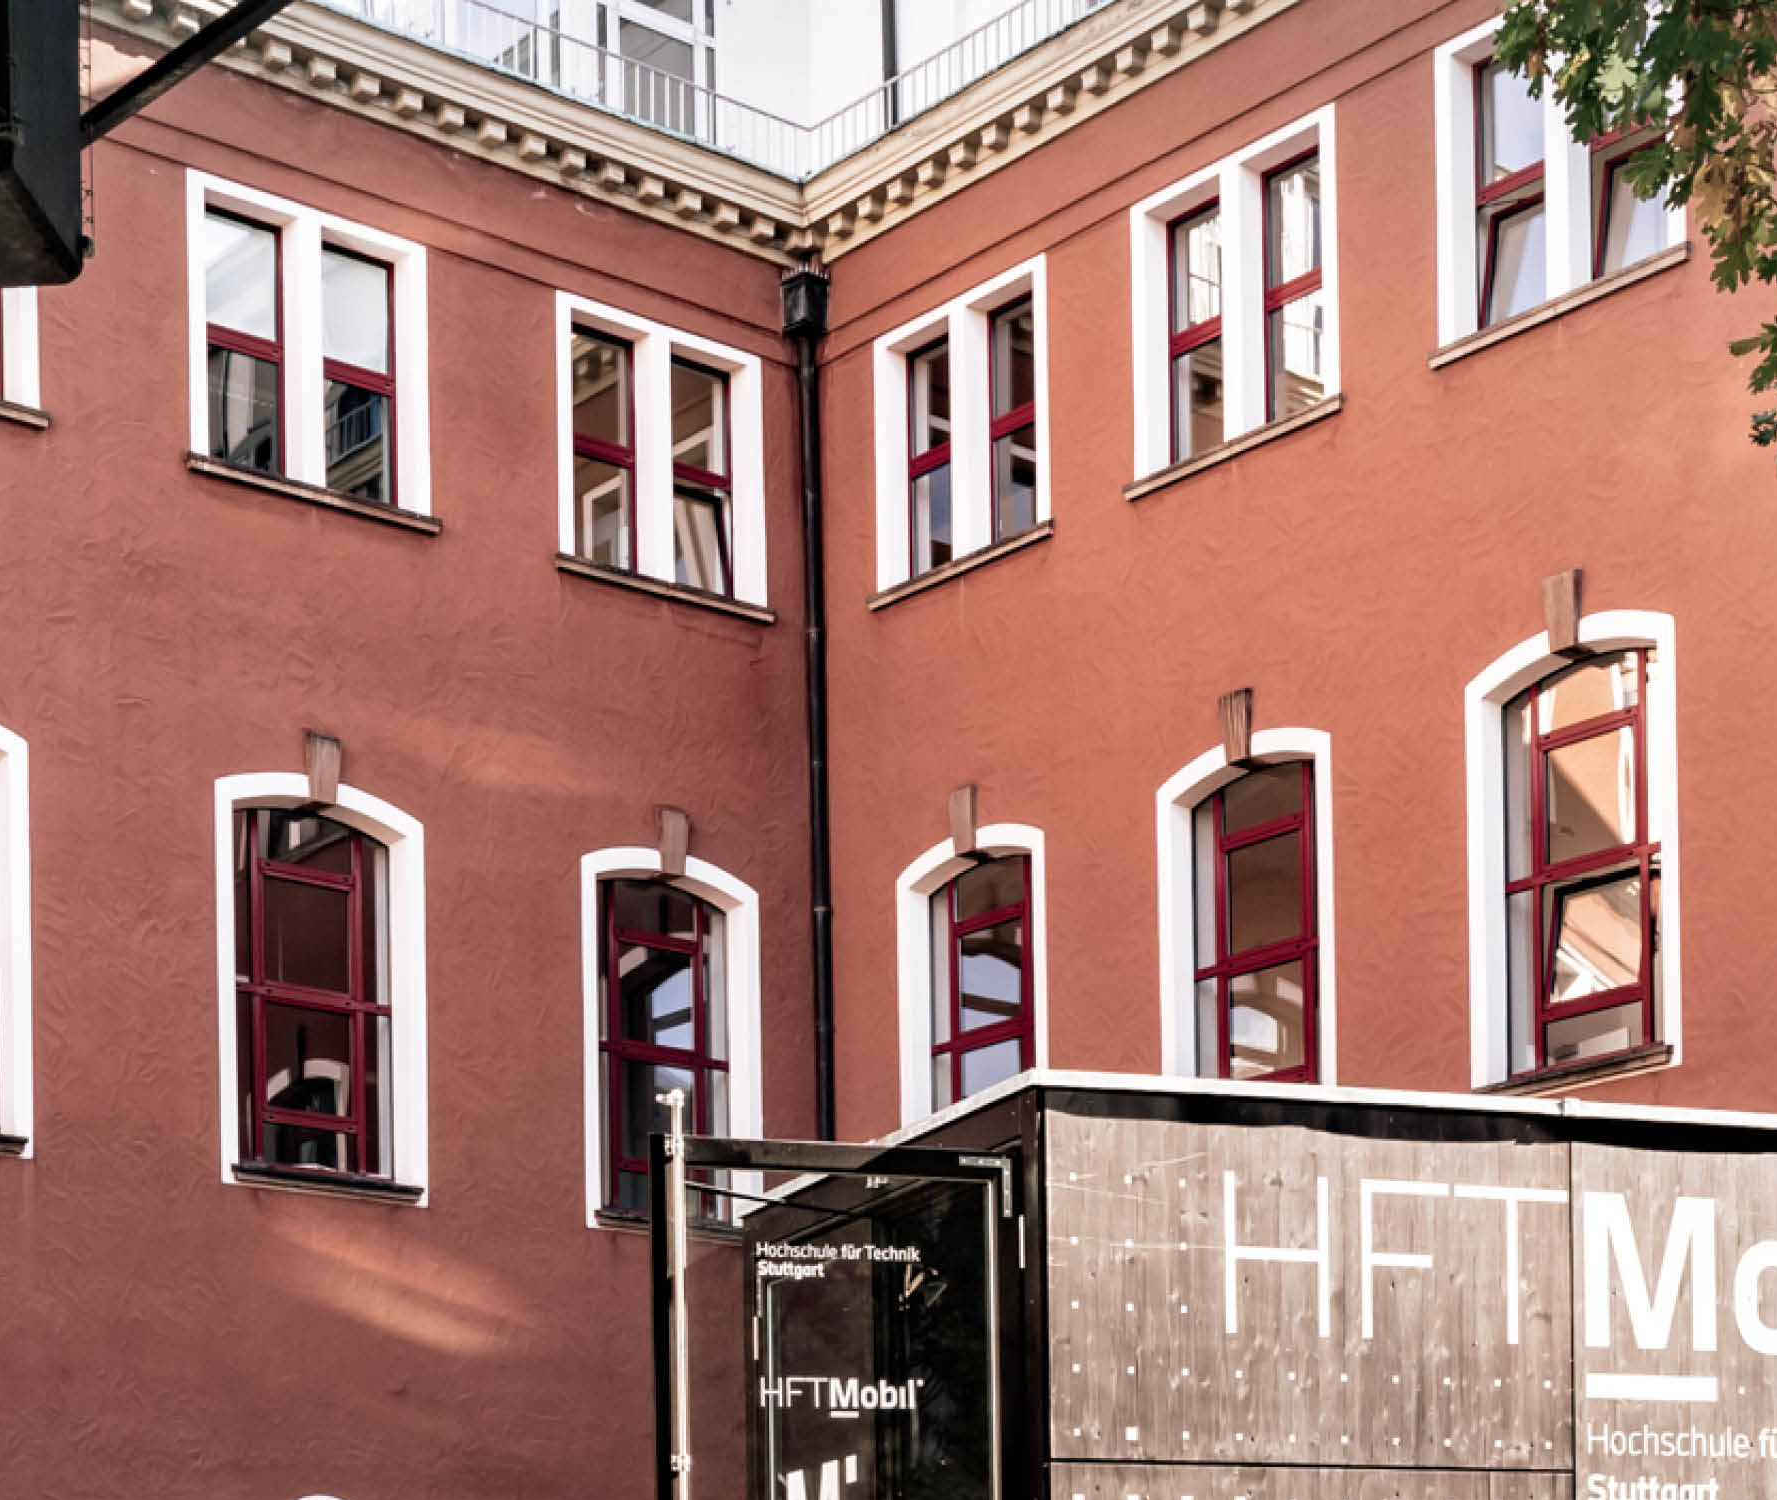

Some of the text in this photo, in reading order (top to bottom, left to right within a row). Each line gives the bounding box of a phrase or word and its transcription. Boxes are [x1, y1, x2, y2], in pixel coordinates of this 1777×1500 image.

[755, 1241, 922, 1262] Hochschule für Technik
[757, 1260, 826, 1280] Stuttgart
[1587, 1423, 1751, 1458] Hochschule
